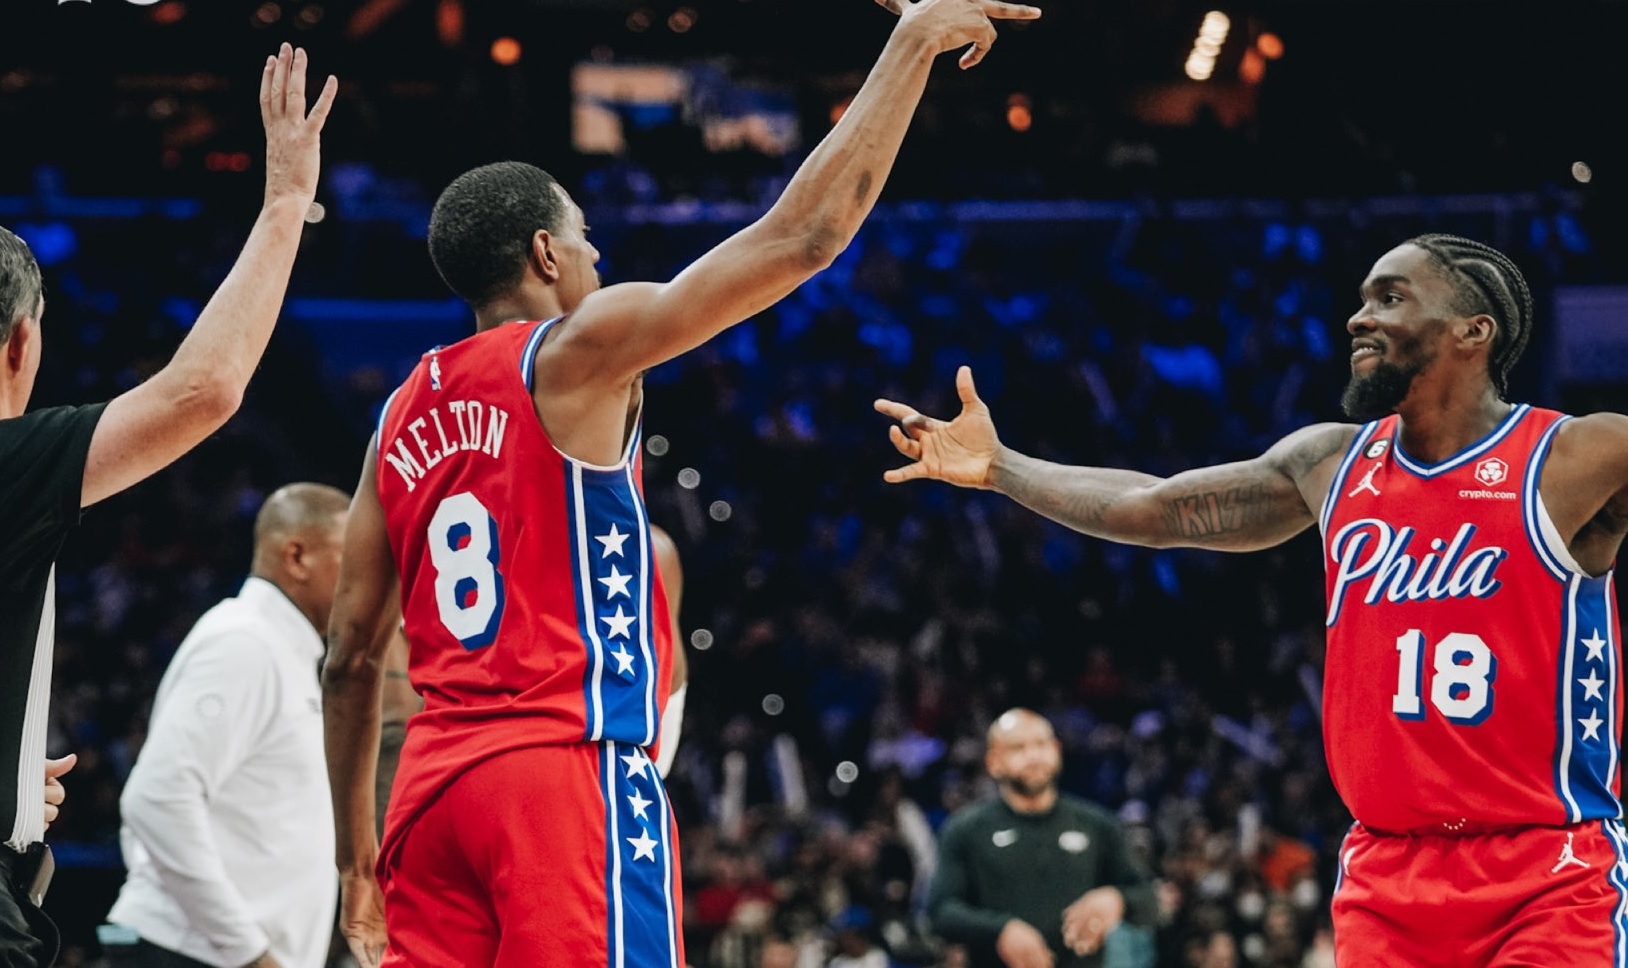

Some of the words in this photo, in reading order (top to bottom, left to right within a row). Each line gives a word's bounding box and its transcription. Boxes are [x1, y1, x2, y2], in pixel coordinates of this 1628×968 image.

[385, 400, 508, 492] MELTON
[1367, 440, 1388, 458] 6
[1458, 489, 1517, 500] crypto.com
[427, 491, 505, 652] 8
[1326, 518, 1509, 627] Phila
[1393, 629, 1498, 726] 18
